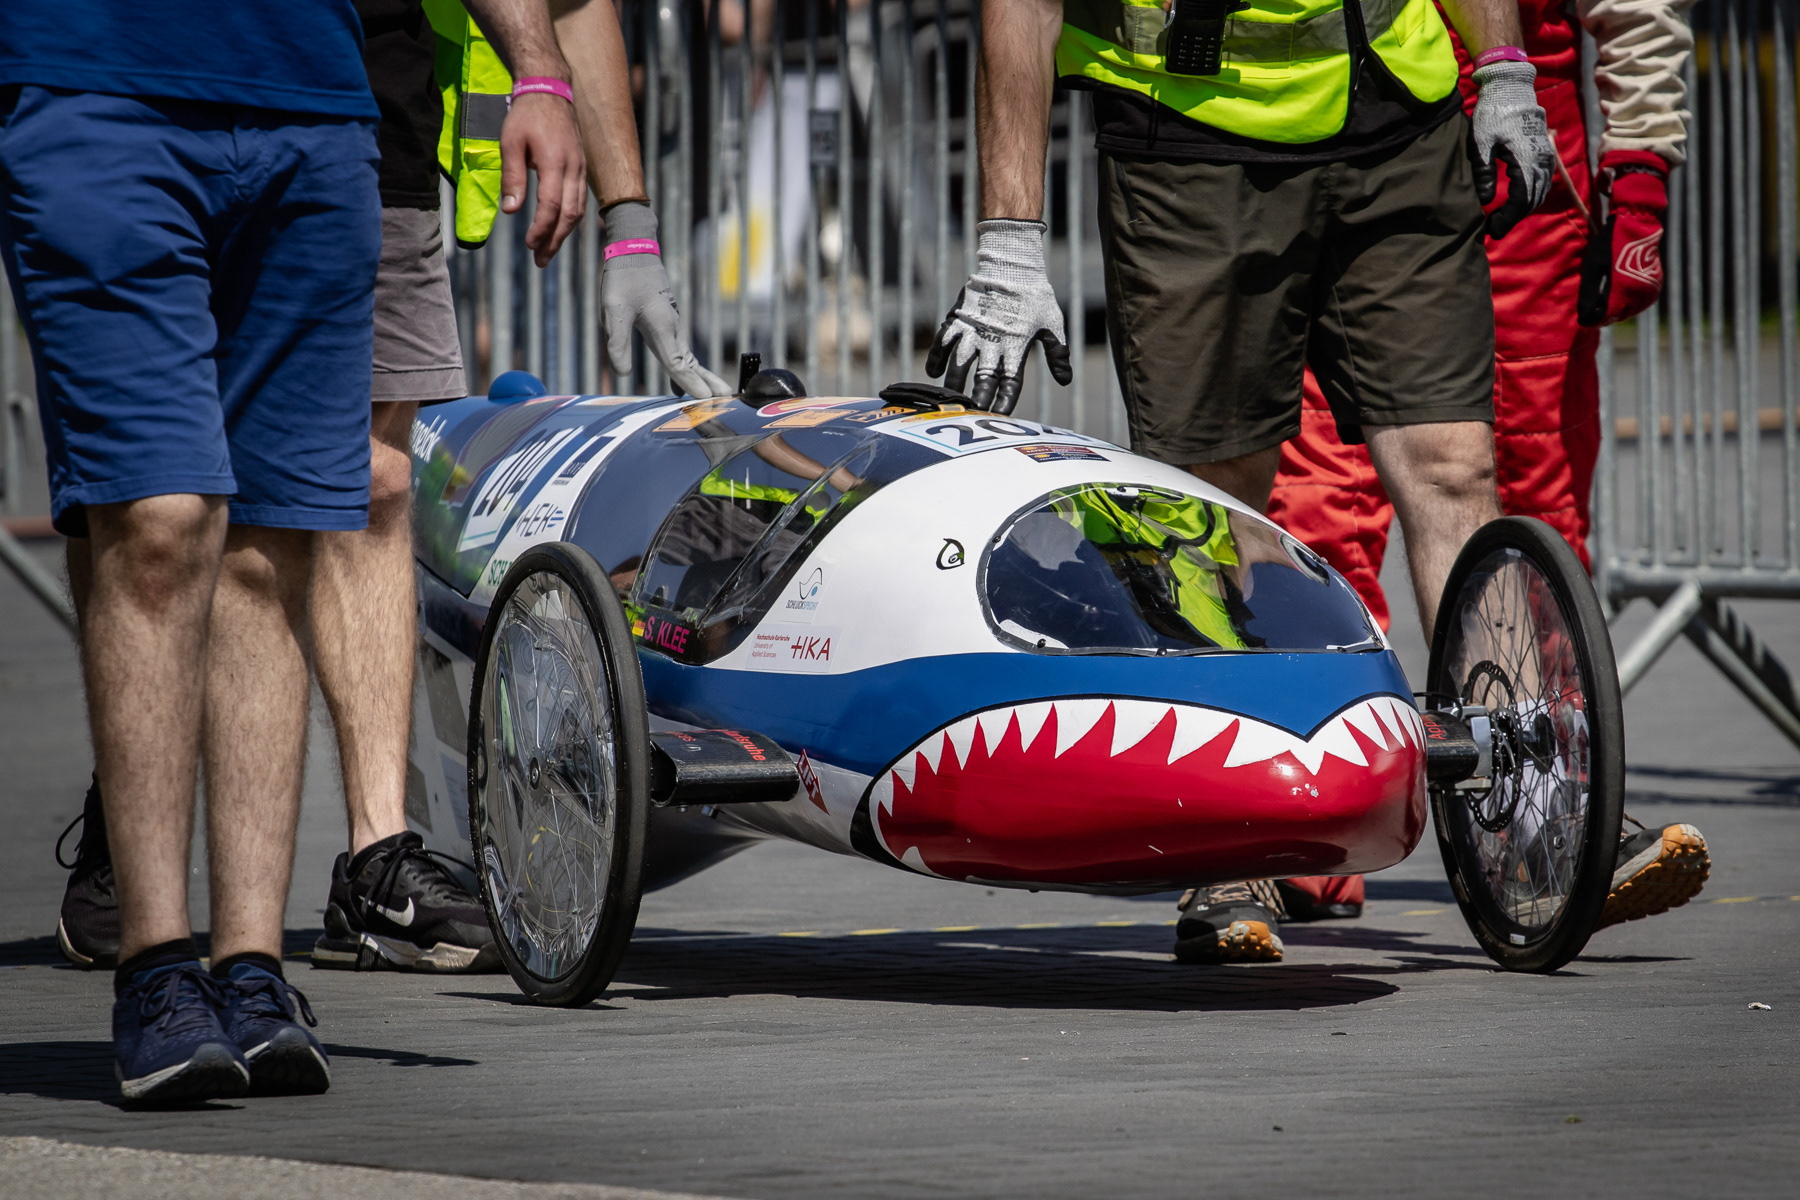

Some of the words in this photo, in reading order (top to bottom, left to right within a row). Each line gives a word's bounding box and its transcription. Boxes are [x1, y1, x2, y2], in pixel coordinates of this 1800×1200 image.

[473, 428, 583, 517] 204
[516, 503, 559, 538] HEK
[785, 600, 819, 611] SCHLUCKSPECHT
[644, 616, 654, 640] S.
[656, 622, 690, 654] KLEE
[791, 636, 831, 661] HKA
[798, 754, 819, 799] LIFT
